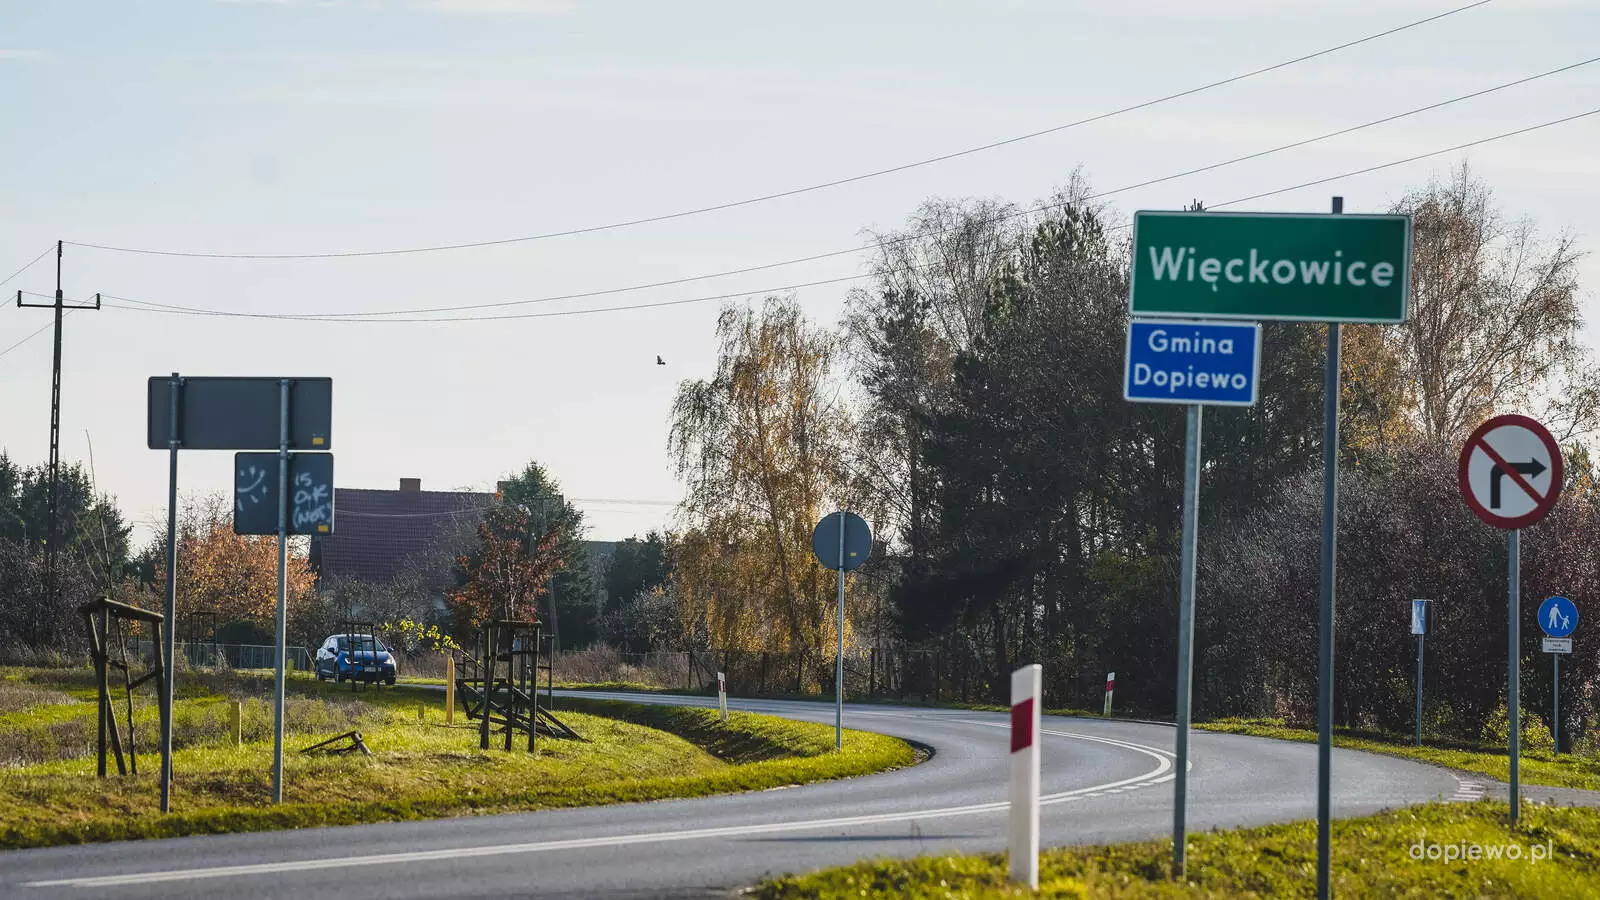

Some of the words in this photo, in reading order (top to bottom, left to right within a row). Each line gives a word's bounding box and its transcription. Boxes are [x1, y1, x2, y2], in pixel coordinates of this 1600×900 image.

[1149, 246, 1395, 293] Więckowice
[1148, 329, 1234, 355] Gmina
[1133, 363, 1248, 393] Dopiewo
